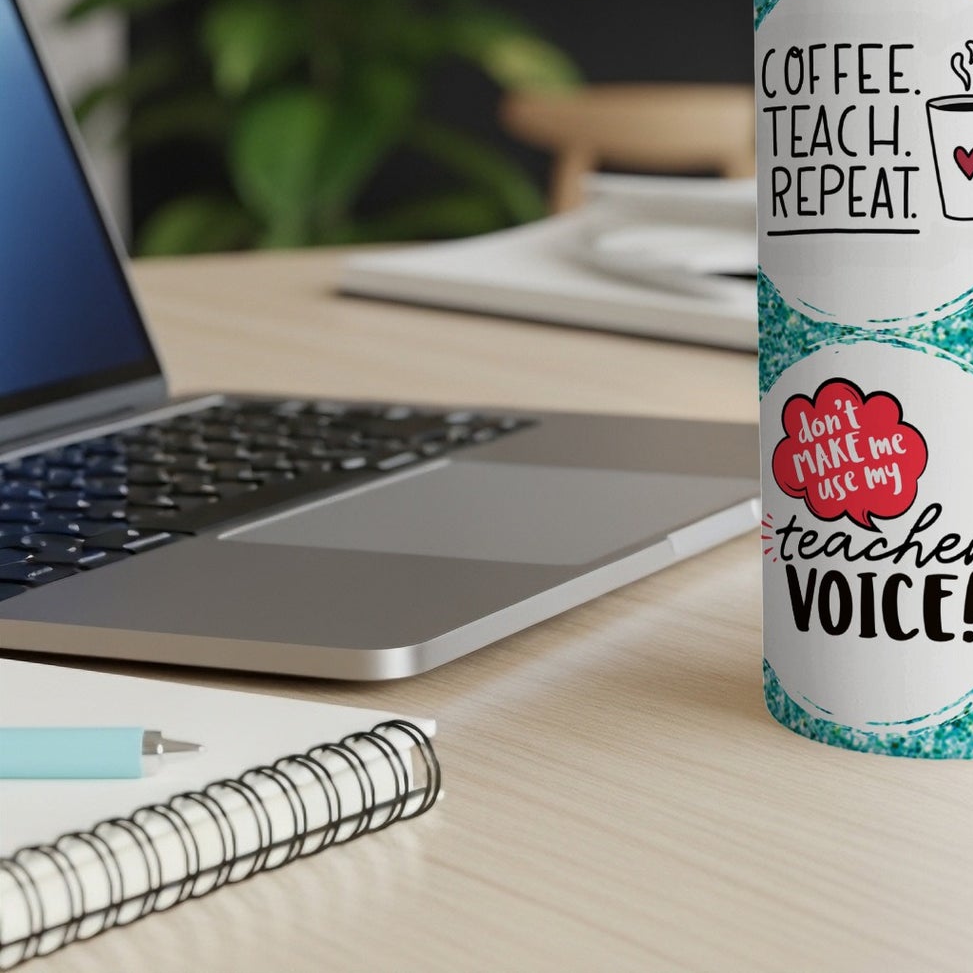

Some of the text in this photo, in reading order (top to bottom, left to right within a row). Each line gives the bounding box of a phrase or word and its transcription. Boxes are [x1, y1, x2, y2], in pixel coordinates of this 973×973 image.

[762, 43, 921, 98] COFFEE.
[763, 104, 911, 157] TEACH.
[772, 165, 919, 218] REPEAT.
[798, 399, 861, 444] don't
[793, 431, 906, 483] MAKE me
[818, 461, 902, 501] use my
